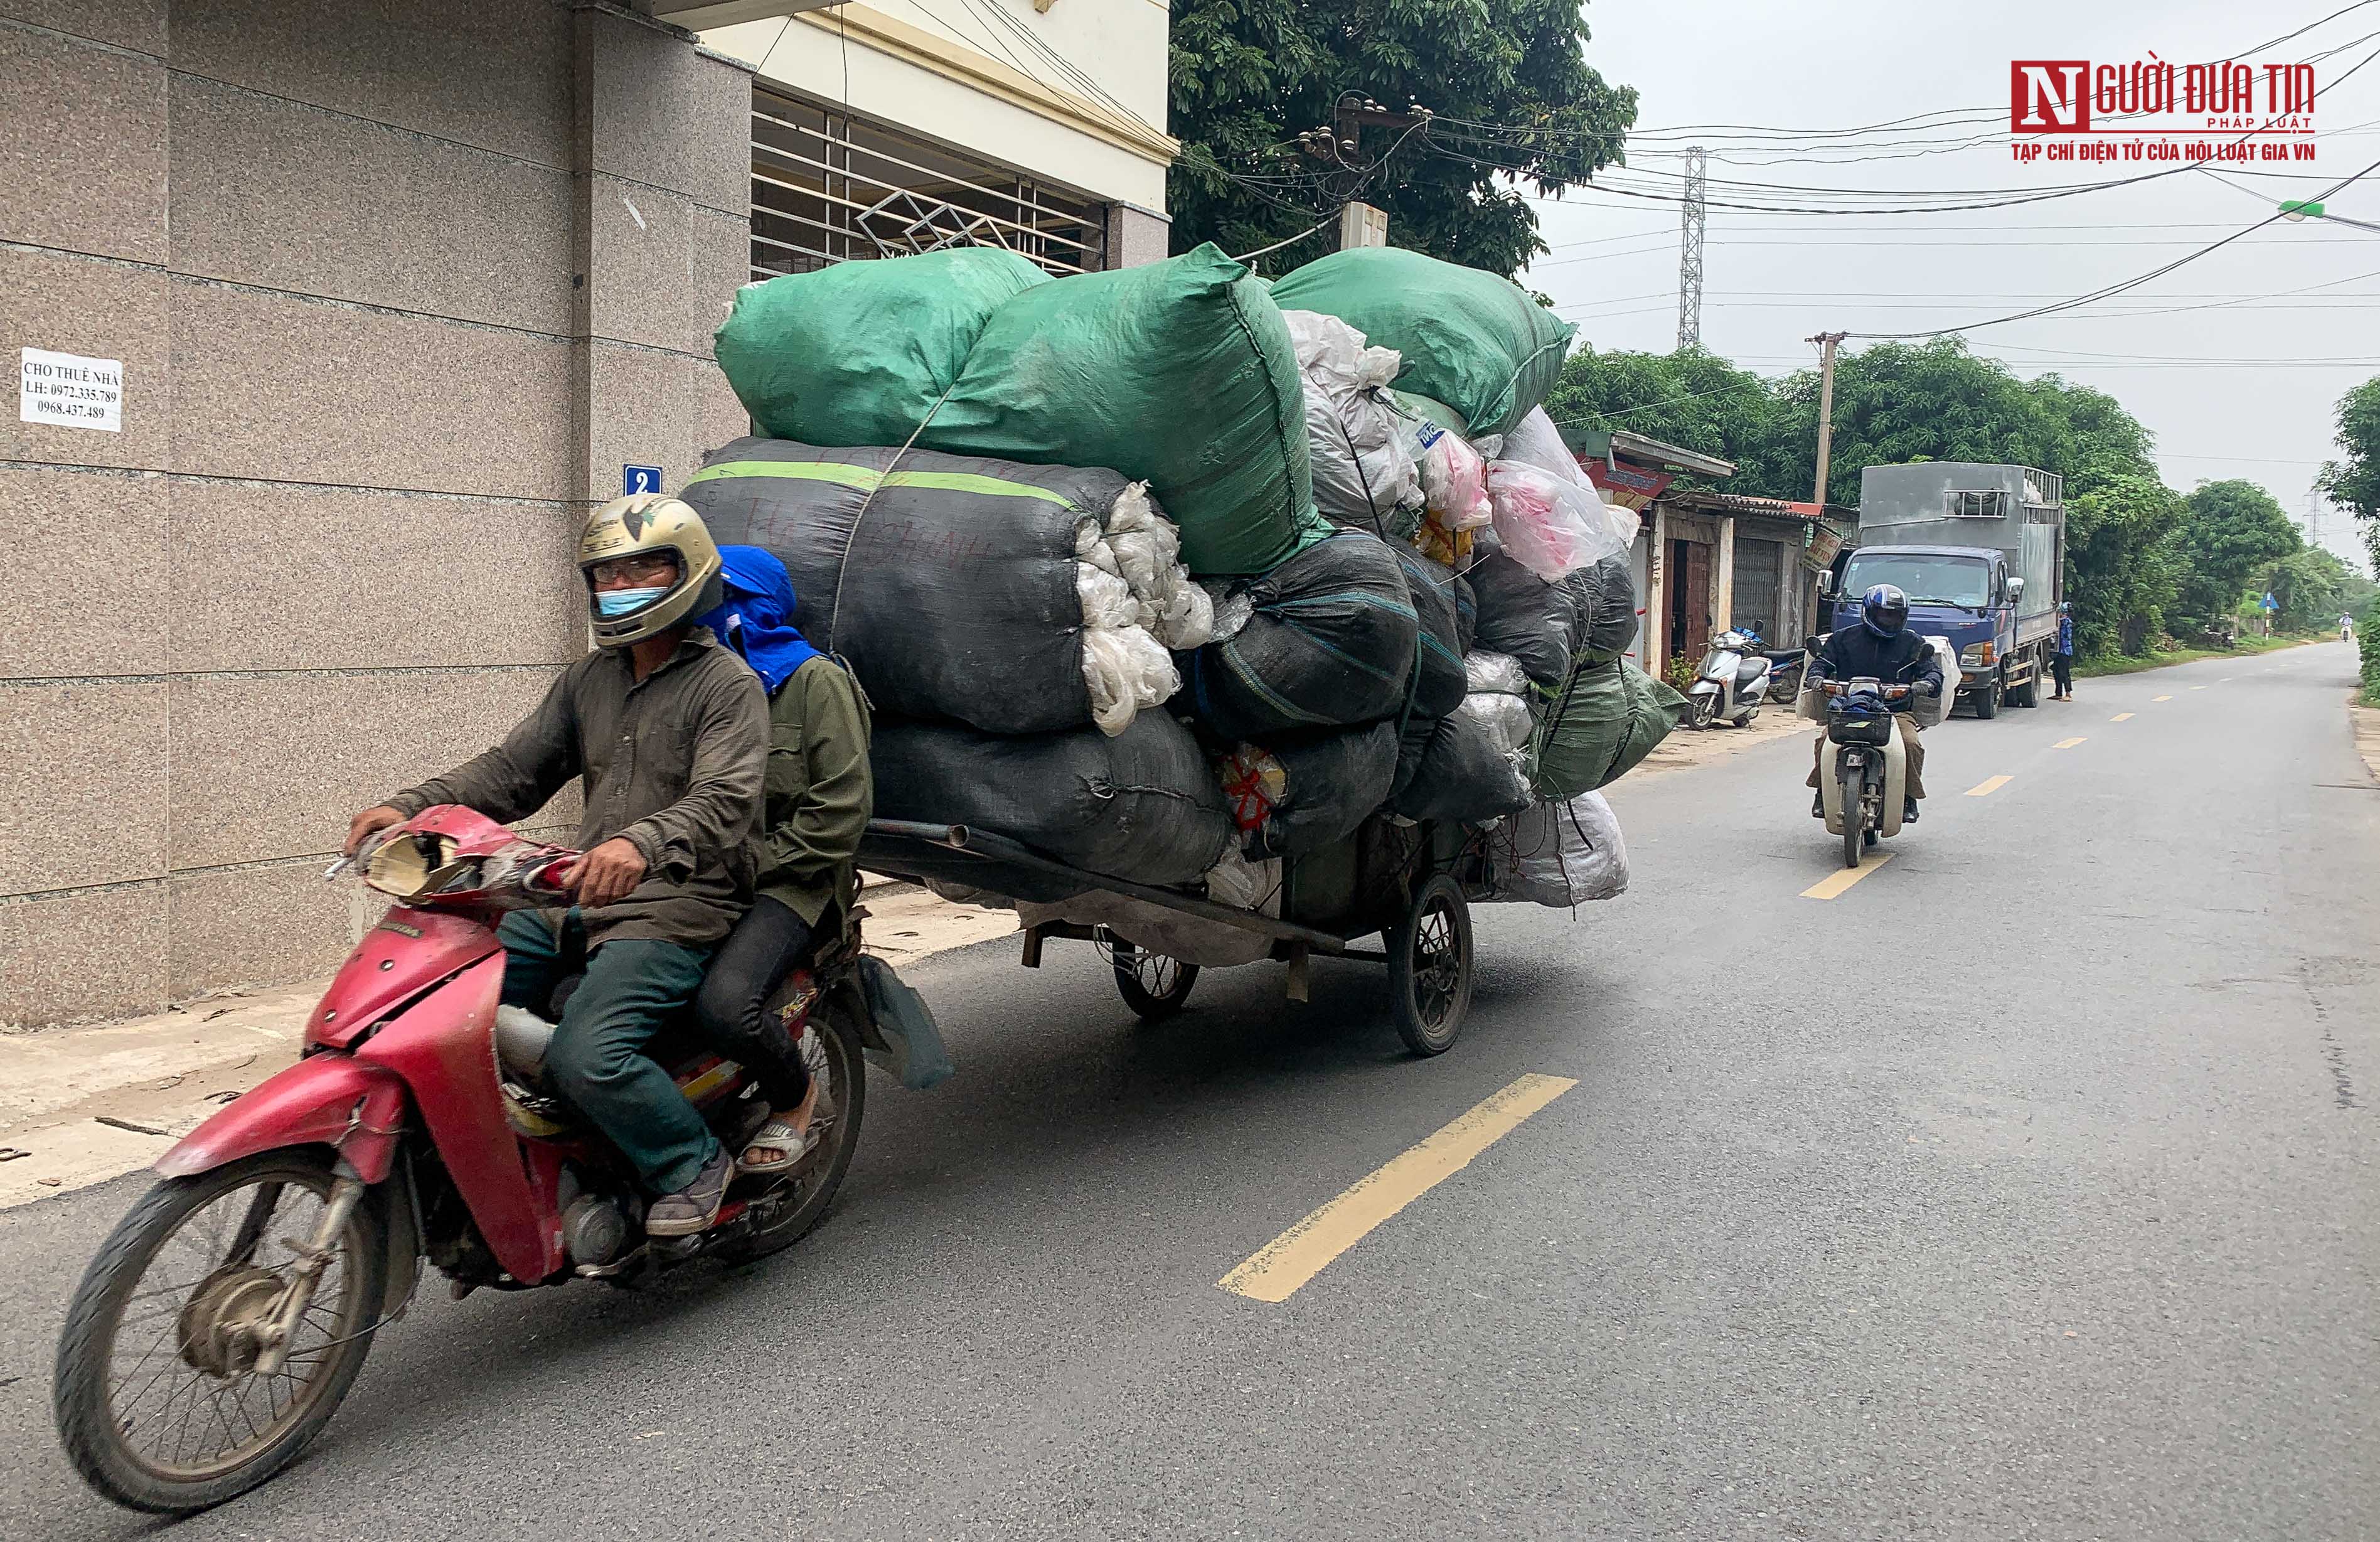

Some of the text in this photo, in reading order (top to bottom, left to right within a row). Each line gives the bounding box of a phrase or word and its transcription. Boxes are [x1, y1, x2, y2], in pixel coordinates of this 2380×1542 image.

[24, 362, 119, 386] CHO THUÊ NHÀ
[26, 381, 117, 402] LH: 0972.335.789
[38, 400, 105, 419] 0968.437.489
[636, 472, 649, 495] 2
